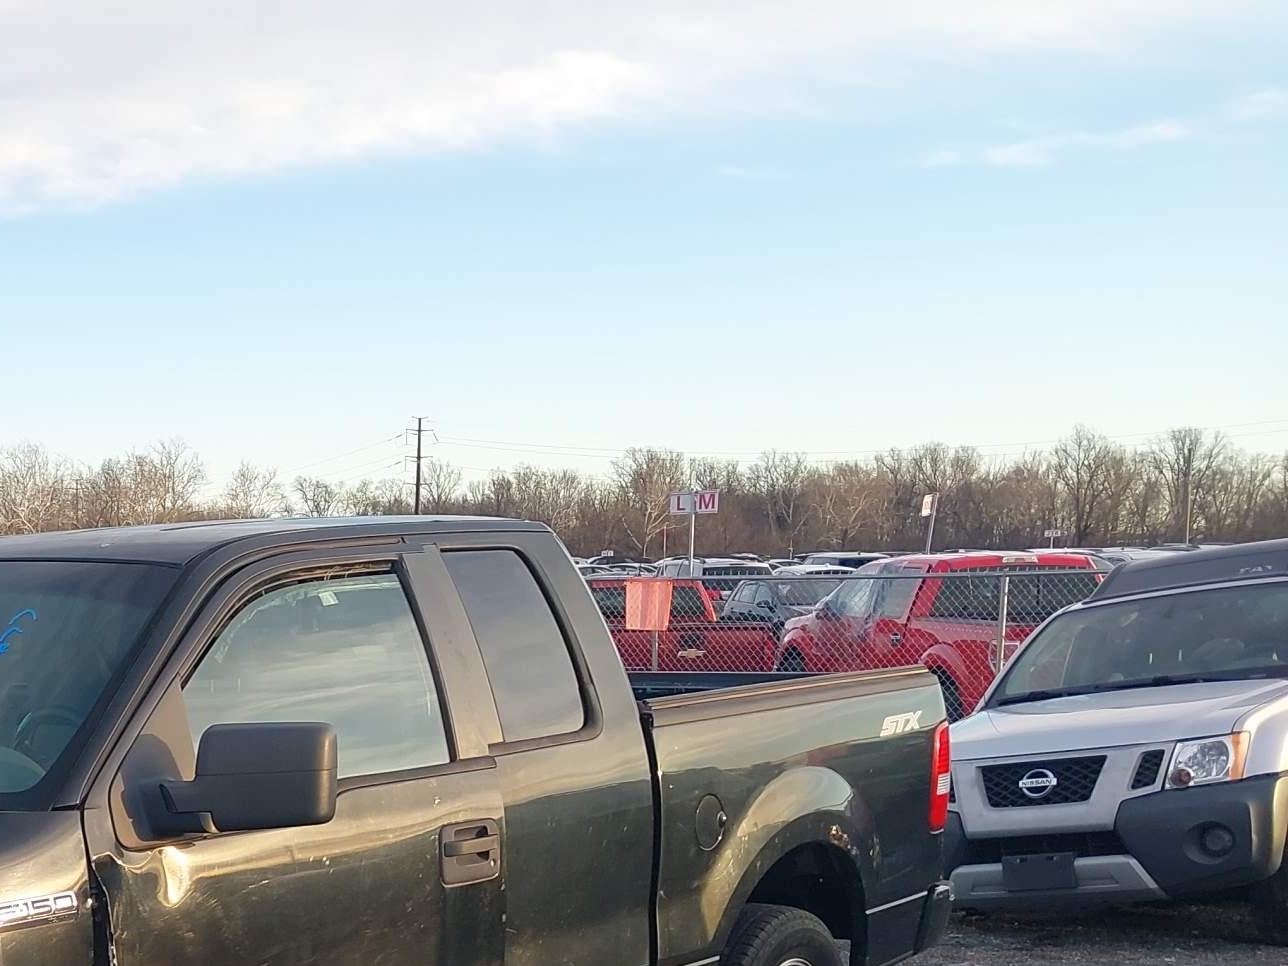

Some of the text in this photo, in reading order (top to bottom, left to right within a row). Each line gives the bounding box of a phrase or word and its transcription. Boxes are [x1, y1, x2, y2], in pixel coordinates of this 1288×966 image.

[677, 493, 716, 511] L M
[880, 710, 922, 736] STX
[1021, 778, 1052, 786] NISSAN
